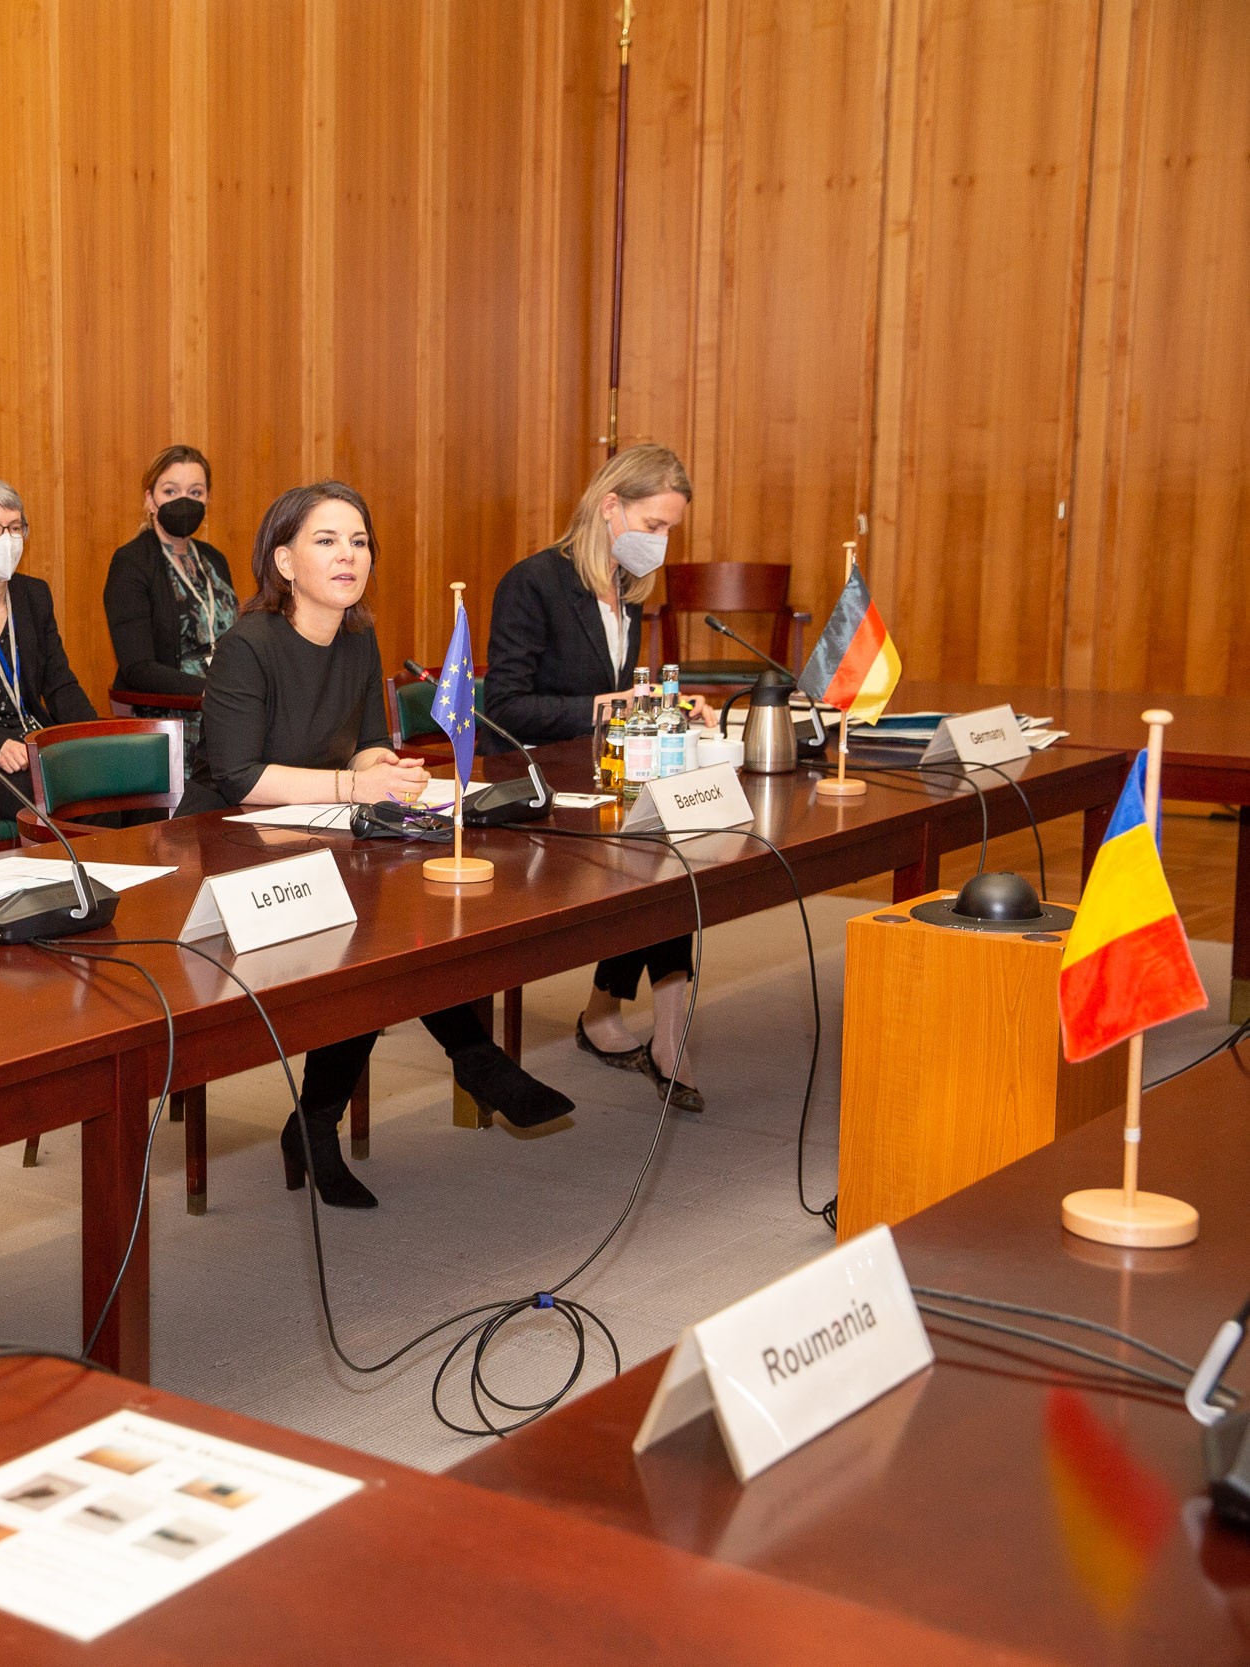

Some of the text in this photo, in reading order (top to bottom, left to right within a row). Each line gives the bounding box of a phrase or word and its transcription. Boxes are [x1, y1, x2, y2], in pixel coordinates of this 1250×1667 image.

[970, 728, 1006, 744] Germany
[674, 784, 724, 809] Baerbock
[251, 882, 312, 909] Le Drian
[762, 1299, 877, 1387] Roumania
